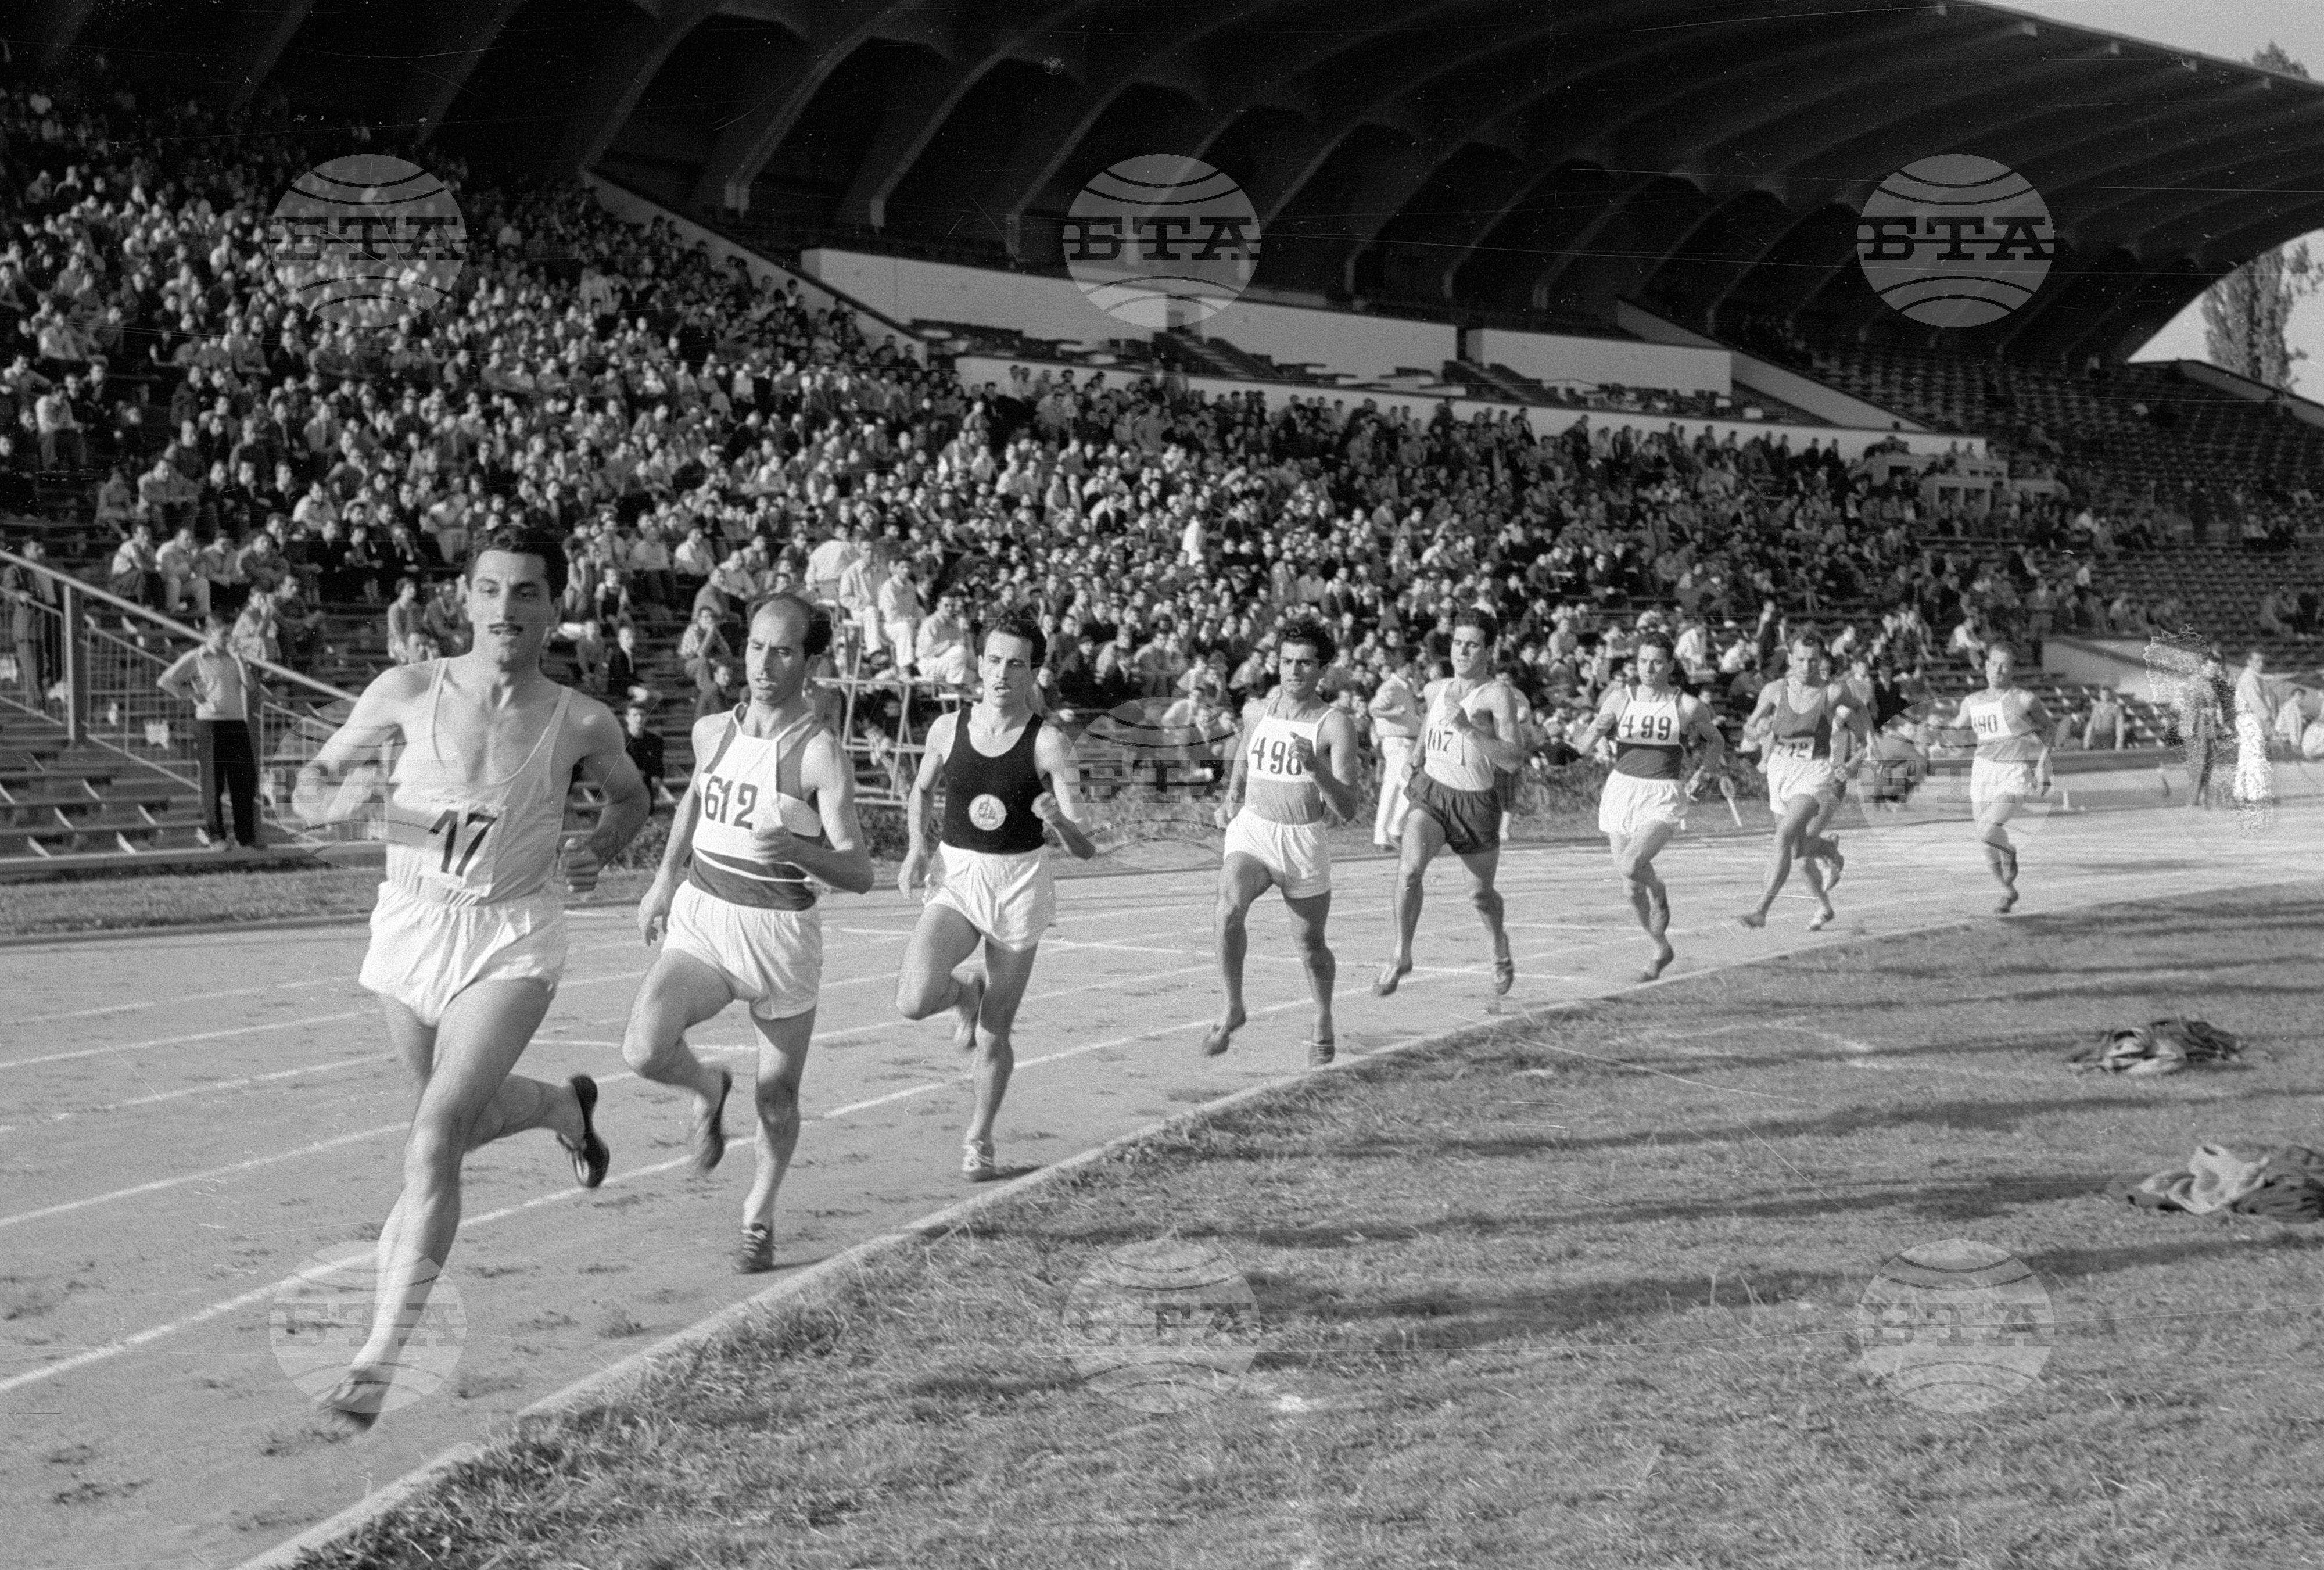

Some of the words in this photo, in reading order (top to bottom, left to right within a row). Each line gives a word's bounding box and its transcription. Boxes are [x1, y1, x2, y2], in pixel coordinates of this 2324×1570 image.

[1621, 714, 1672, 741] 499
[705, 775, 758, 830] 612
[429, 809, 498, 877] 17
